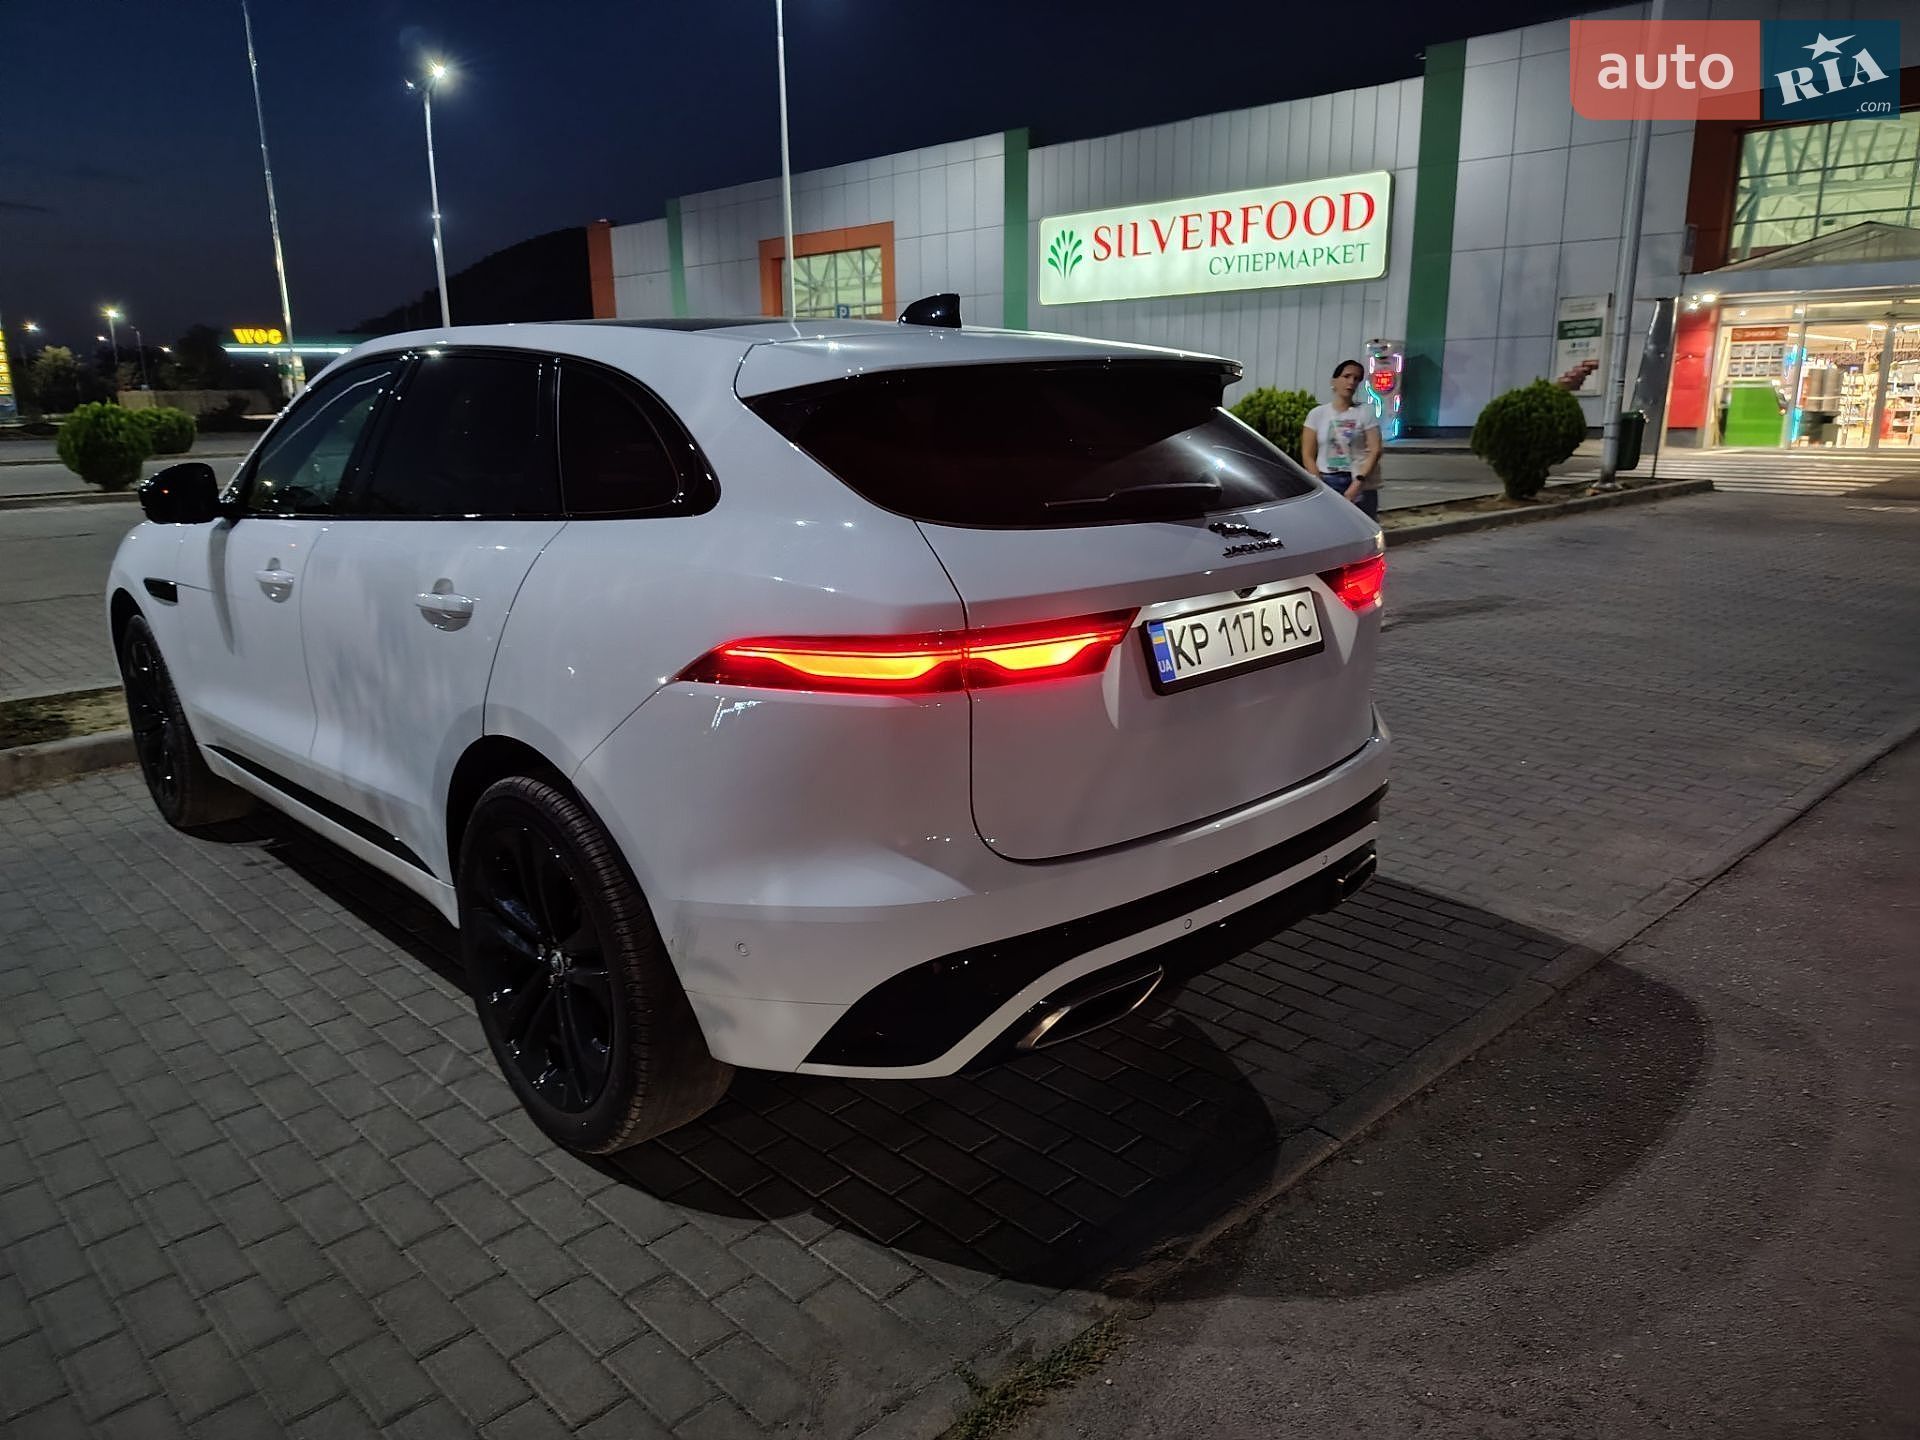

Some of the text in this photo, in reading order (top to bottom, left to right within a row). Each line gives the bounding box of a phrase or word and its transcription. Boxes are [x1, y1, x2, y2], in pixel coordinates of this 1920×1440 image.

[1092, 190, 1377, 263] SILVERFOOD
[1208, 242, 1371, 277] СУПЕРМАРКЕТ
[839, 307, 848, 319] P
[232, 328, 283, 344] WOG
[1167, 602, 1312, 669] KP 1176 AC
[1157, 656, 1174, 674] UA
